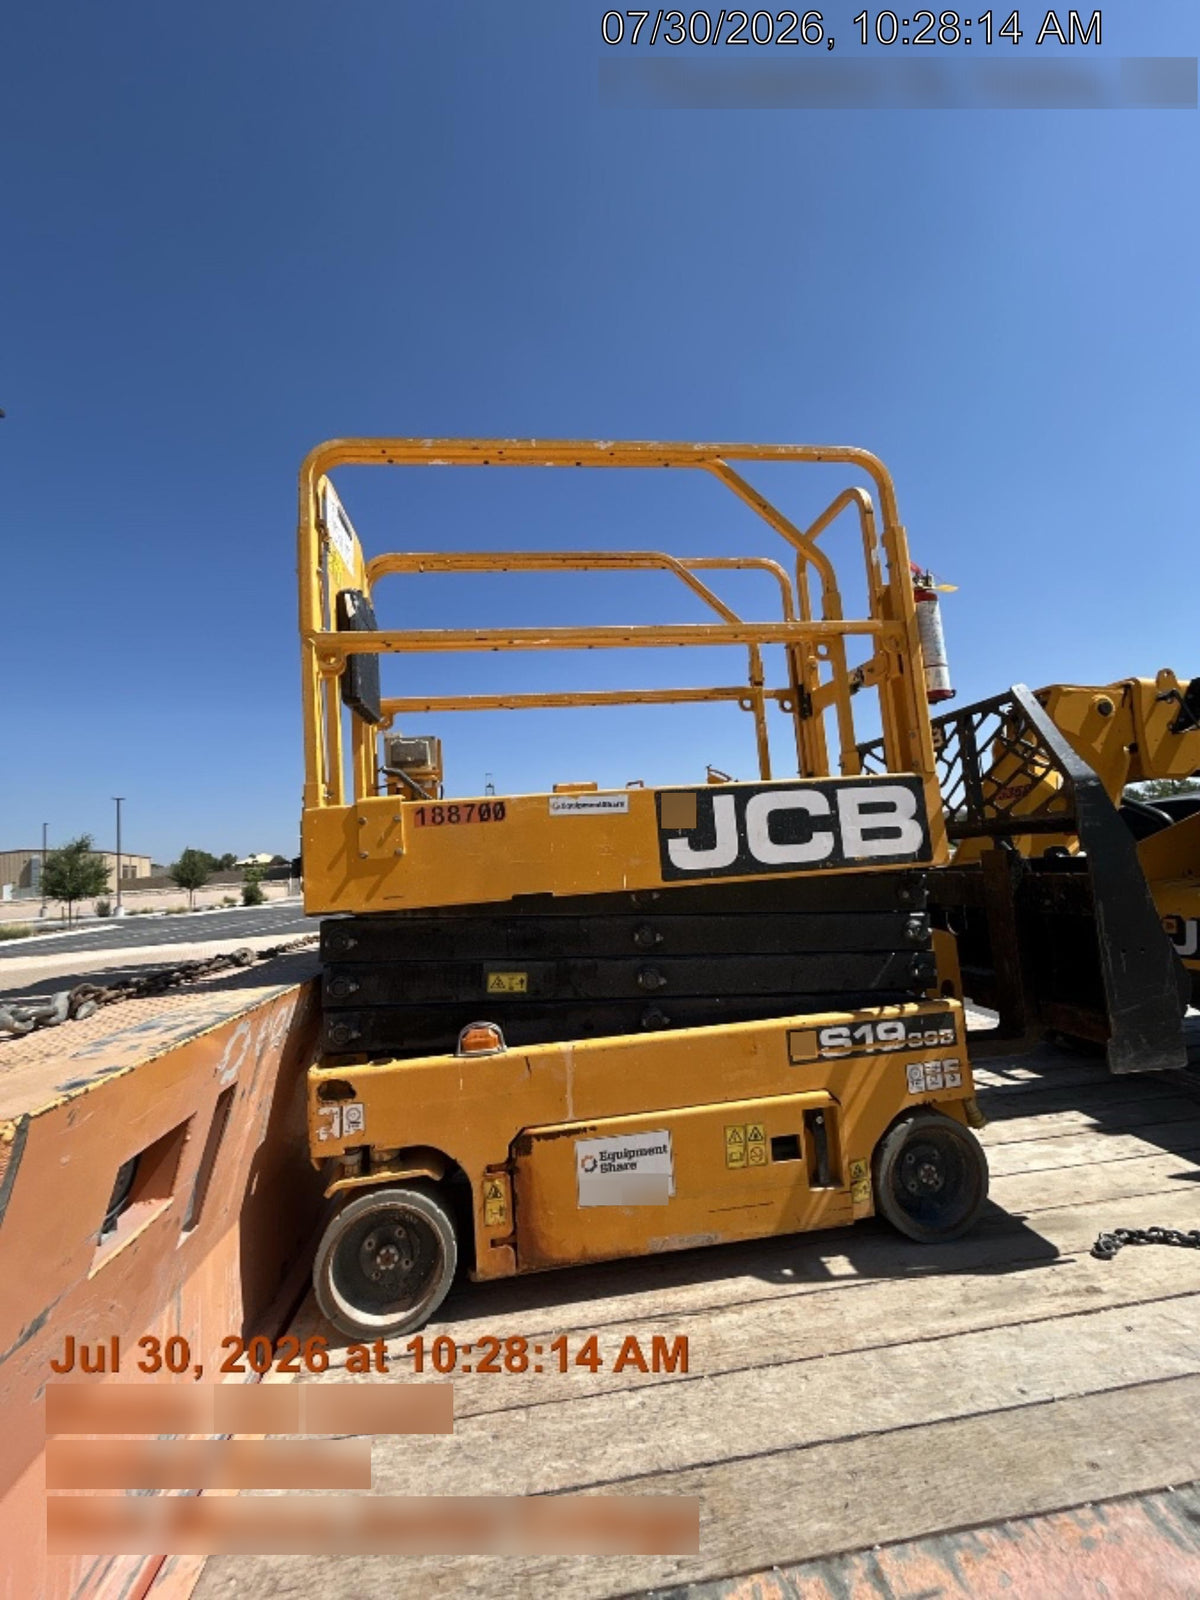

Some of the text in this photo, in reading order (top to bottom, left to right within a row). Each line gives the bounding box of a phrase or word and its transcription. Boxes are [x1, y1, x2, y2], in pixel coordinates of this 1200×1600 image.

[415, 801, 506, 826] 188700
[668, 785, 923, 870] JCB
[599, 1144, 668, 1162] Equipment
[600, 1161, 638, 1174] Share
